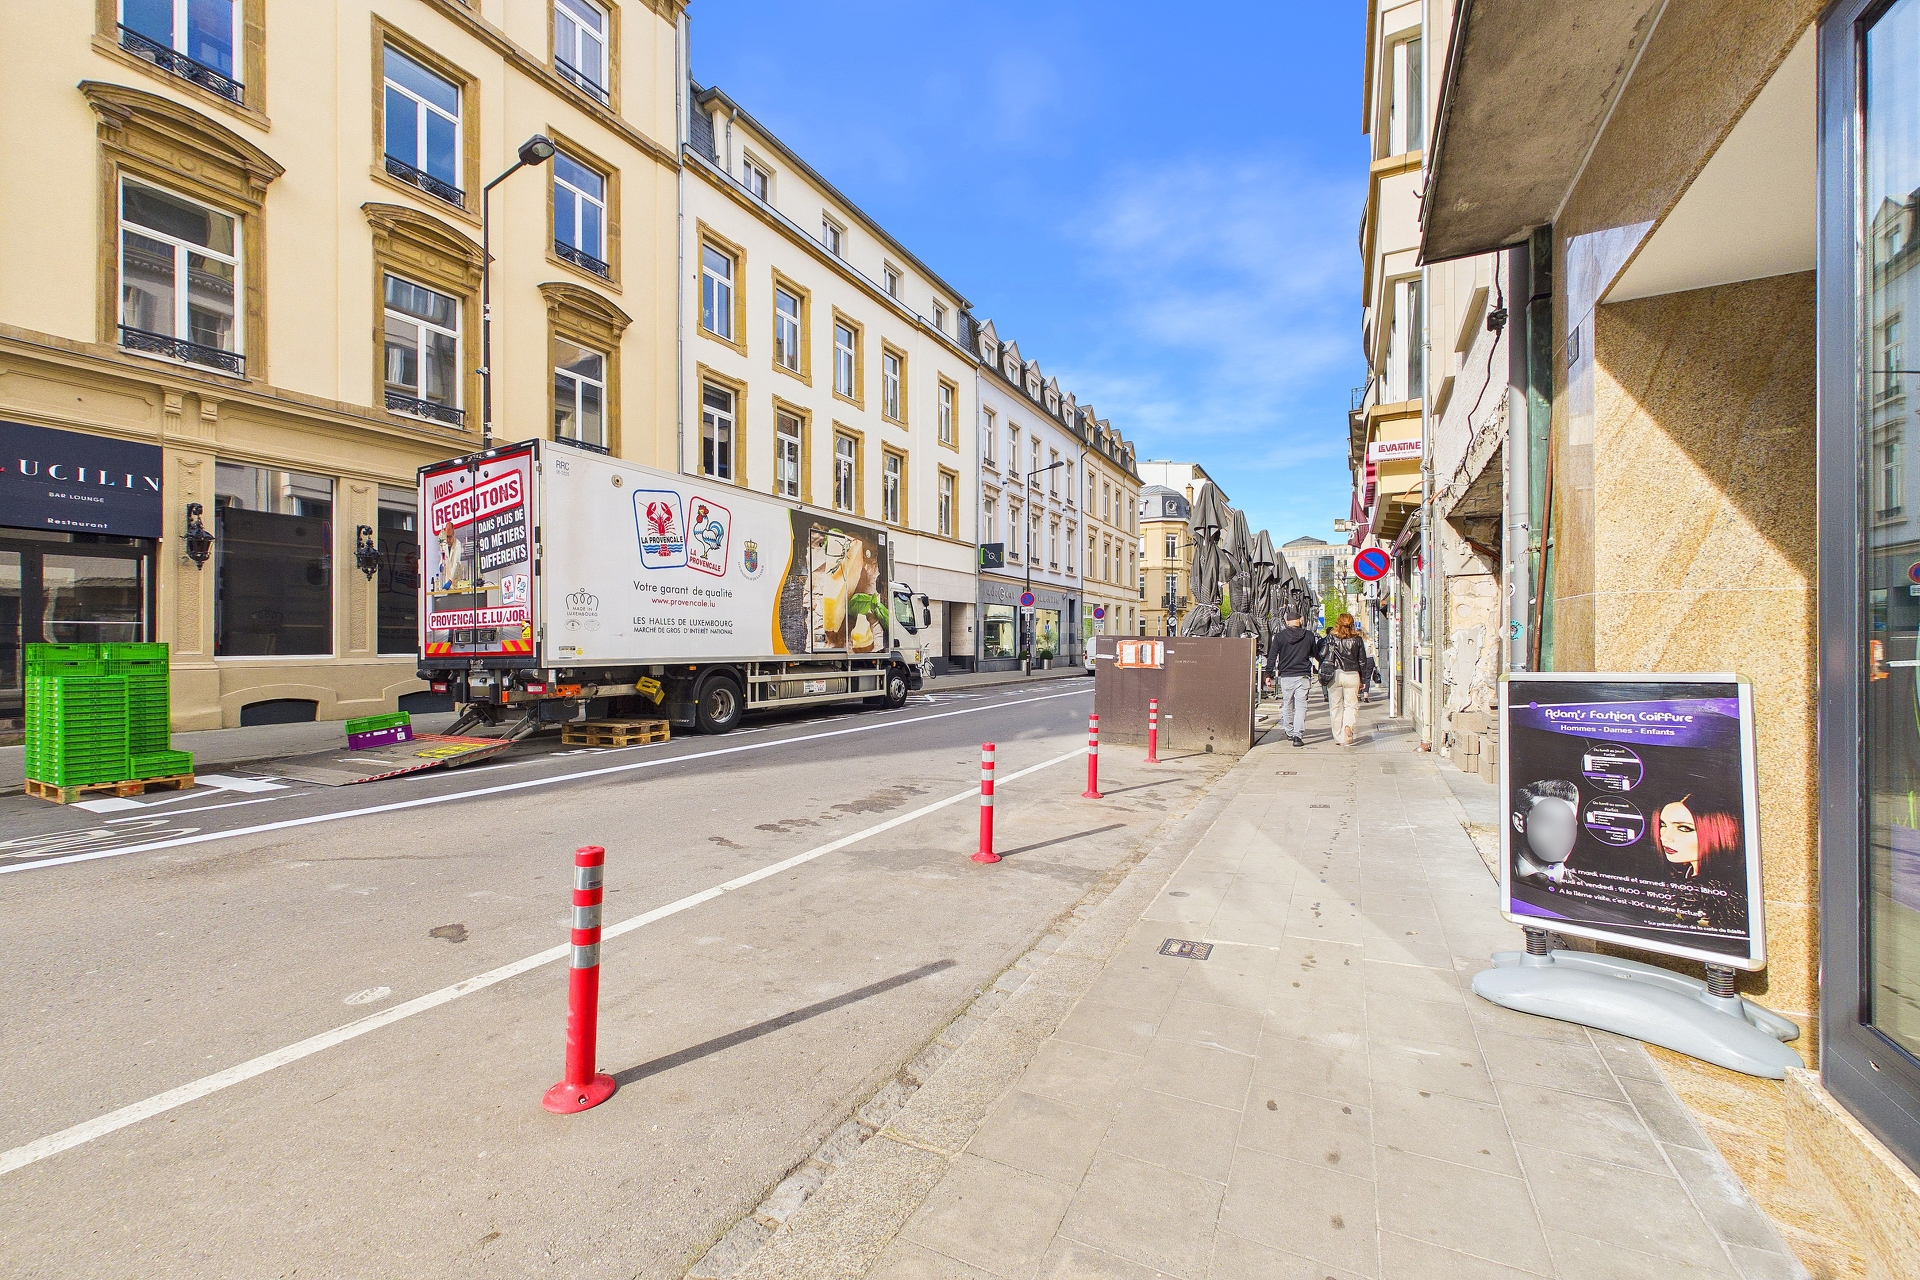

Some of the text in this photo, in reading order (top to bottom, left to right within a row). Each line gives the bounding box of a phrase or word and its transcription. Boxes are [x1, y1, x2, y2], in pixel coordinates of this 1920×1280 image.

[1378, 441, 1421, 453] LEVANTINE
[556, 460, 570, 471] RRC
[434, 480, 454, 500] NOUS
[48, 491, 105, 503] BAR LOUNGE
[435, 479, 519, 526] RECRUTONS
[47, 517, 109, 529] Restaurant
[478, 508, 524, 534] DANS PLUS DE
[479, 525, 525, 552] 90 MÉTIERS
[480, 543, 527, 570] DIFFÉRENTS
[690, 548, 697, 556] LA
[633, 580, 733, 599] Votre garant de qualité
[651, 597, 716, 608] www.provencale.lu
[633, 616, 733, 627] LES HALLES DE LUXEMBOURG
[1545, 709, 1694, 723] Adam's Fashion Coiffure
[1640, 728, 1675, 736] Enfants
[1585, 881, 1614, 892] vendredi
[1599, 873, 1630, 882] mercredi
[1639, 879, 1666, 888] samedi
[1657, 905, 1676, 913] votre
